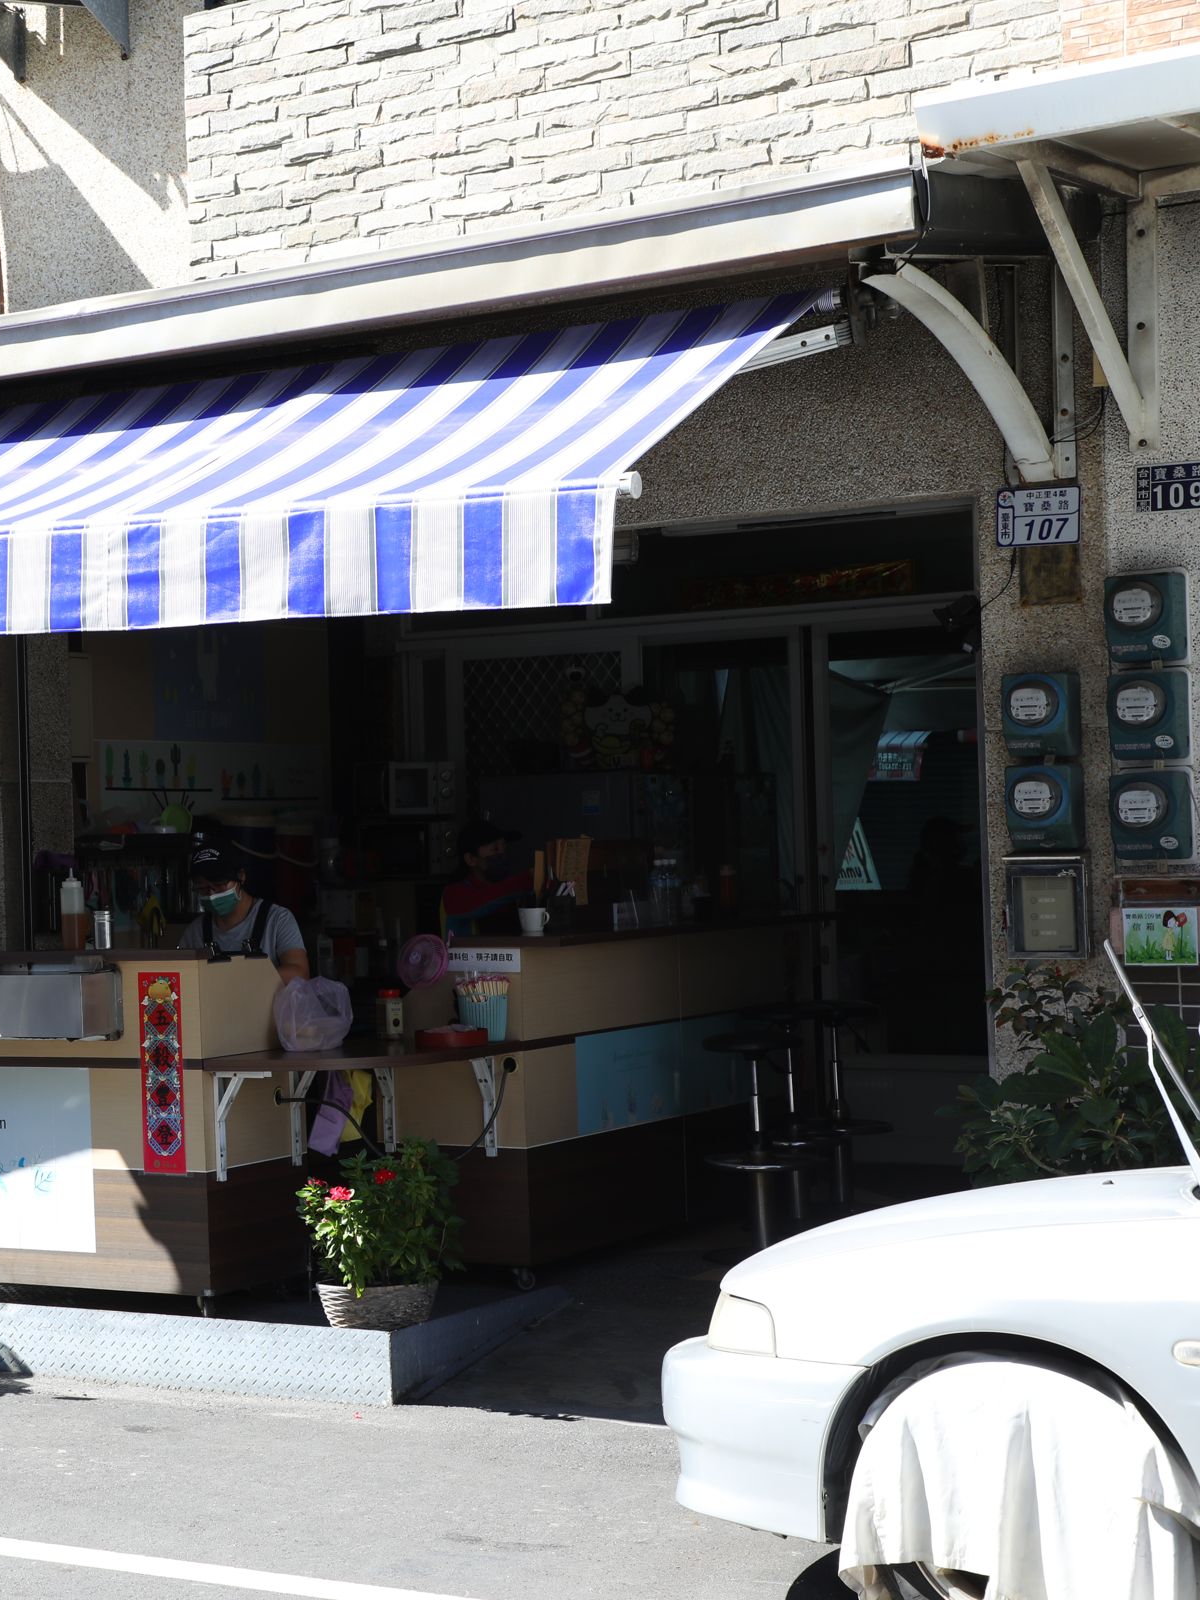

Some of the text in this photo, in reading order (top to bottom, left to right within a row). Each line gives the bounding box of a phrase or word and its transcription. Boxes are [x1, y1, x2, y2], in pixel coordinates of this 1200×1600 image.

[1026, 490, 1067, 500] 中正里4鄰
[1137, 468, 1149, 499] 台東市
[1153, 481, 1200, 510] 109
[1023, 500, 1069, 513] 寶桑路
[1000, 513, 1010, 540] 臺東市
[1024, 517, 1069, 541] 107
